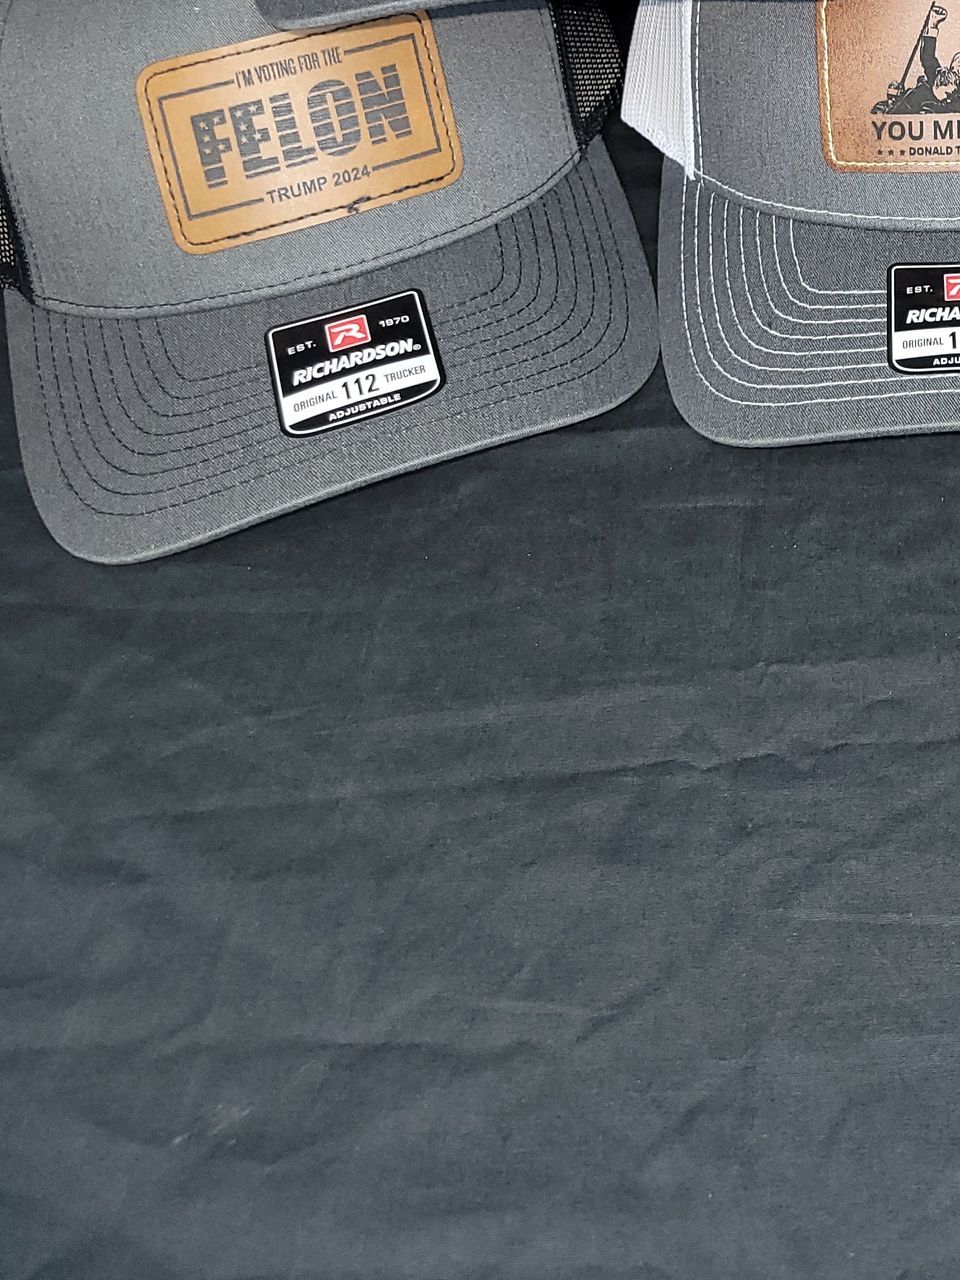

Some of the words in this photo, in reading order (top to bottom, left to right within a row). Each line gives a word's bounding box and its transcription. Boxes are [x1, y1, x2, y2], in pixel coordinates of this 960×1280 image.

[235, 68, 254, 89] I'M
[255, 58, 297, 83] VOTING
[298, 52, 322, 74] FOR
[322, 47, 342, 67] THE
[191, 64, 412, 188] FELON
[871, 120, 924, 141] YOU
[909, 146, 953, 156] DONALD
[266, 178, 328, 204] TRUMP
[333, 165, 371, 187] 2024
[907, 285, 933, 294] EST.
[287, 340, 317, 355] EST.
[379, 315, 409, 328] 1970
[903, 337, 944, 349] ORIGINAL
[294, 391, 337, 412] ORIGINAL
[342, 374, 379, 399] 112
[384, 365, 426, 383] TRUCKER
[329, 393, 401, 421] ADJUSTABLE
